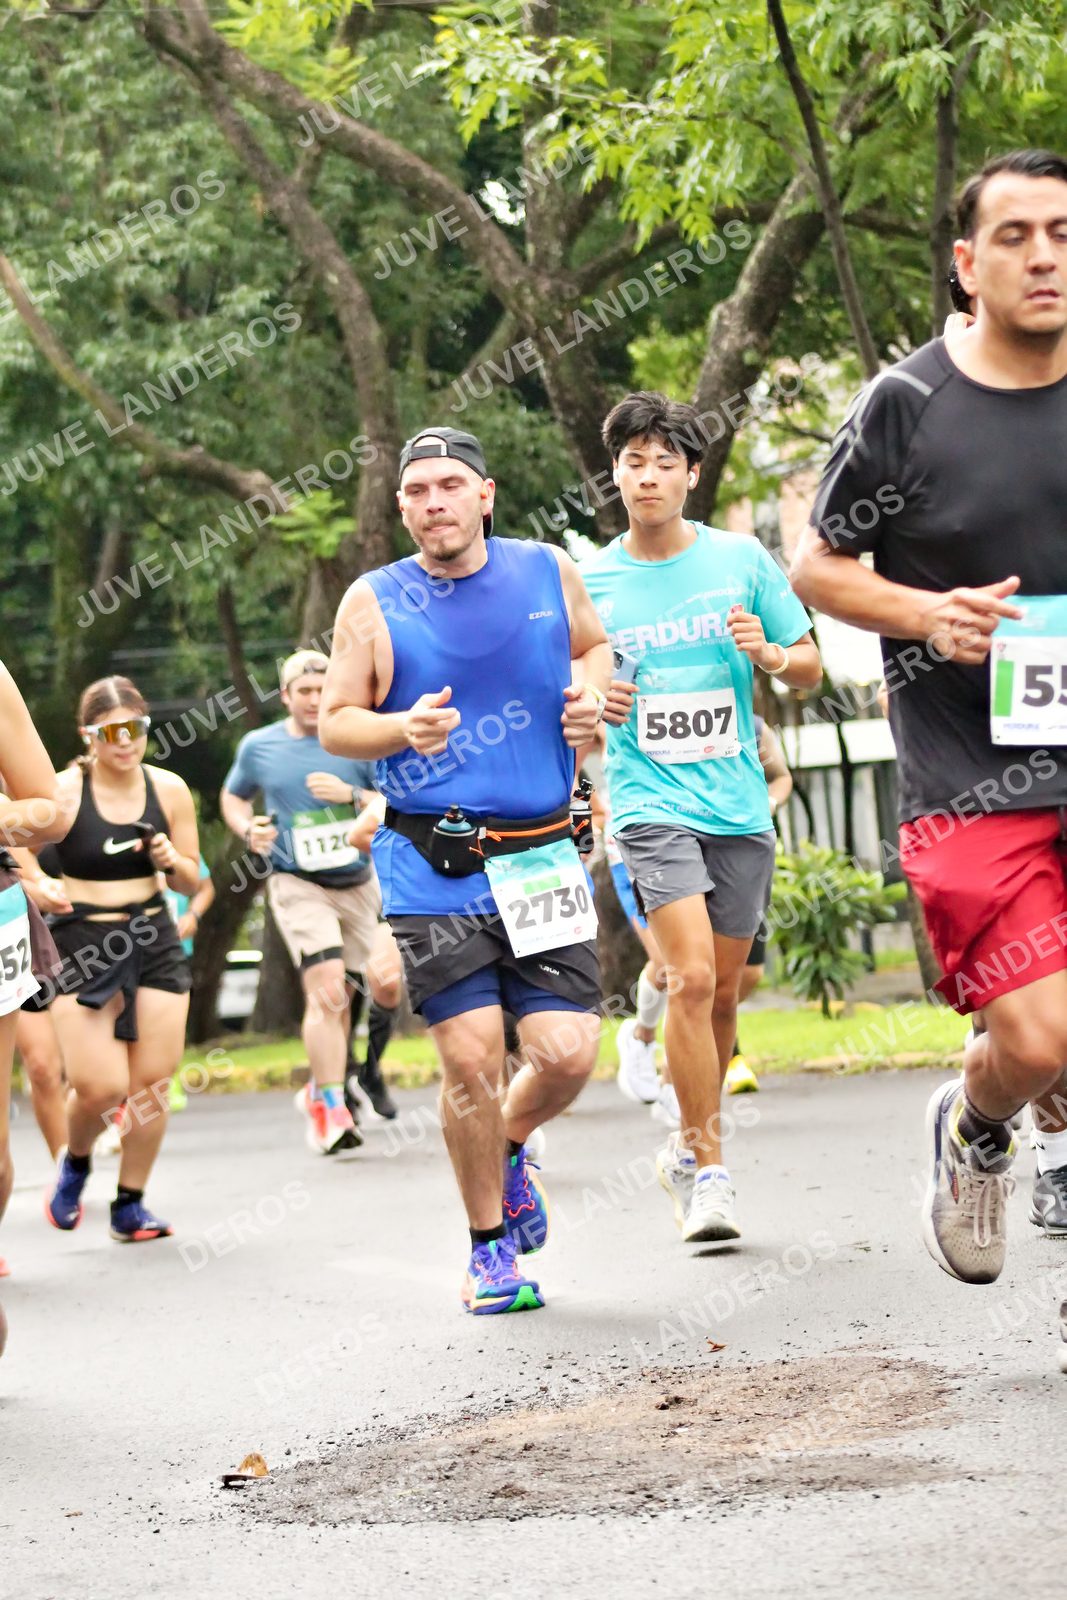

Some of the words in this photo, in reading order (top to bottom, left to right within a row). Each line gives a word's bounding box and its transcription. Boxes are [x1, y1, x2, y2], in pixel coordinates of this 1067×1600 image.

[645, 705, 733, 741] 5807
[507, 884, 589, 931] 2730
[0, 936, 29, 986] 52
